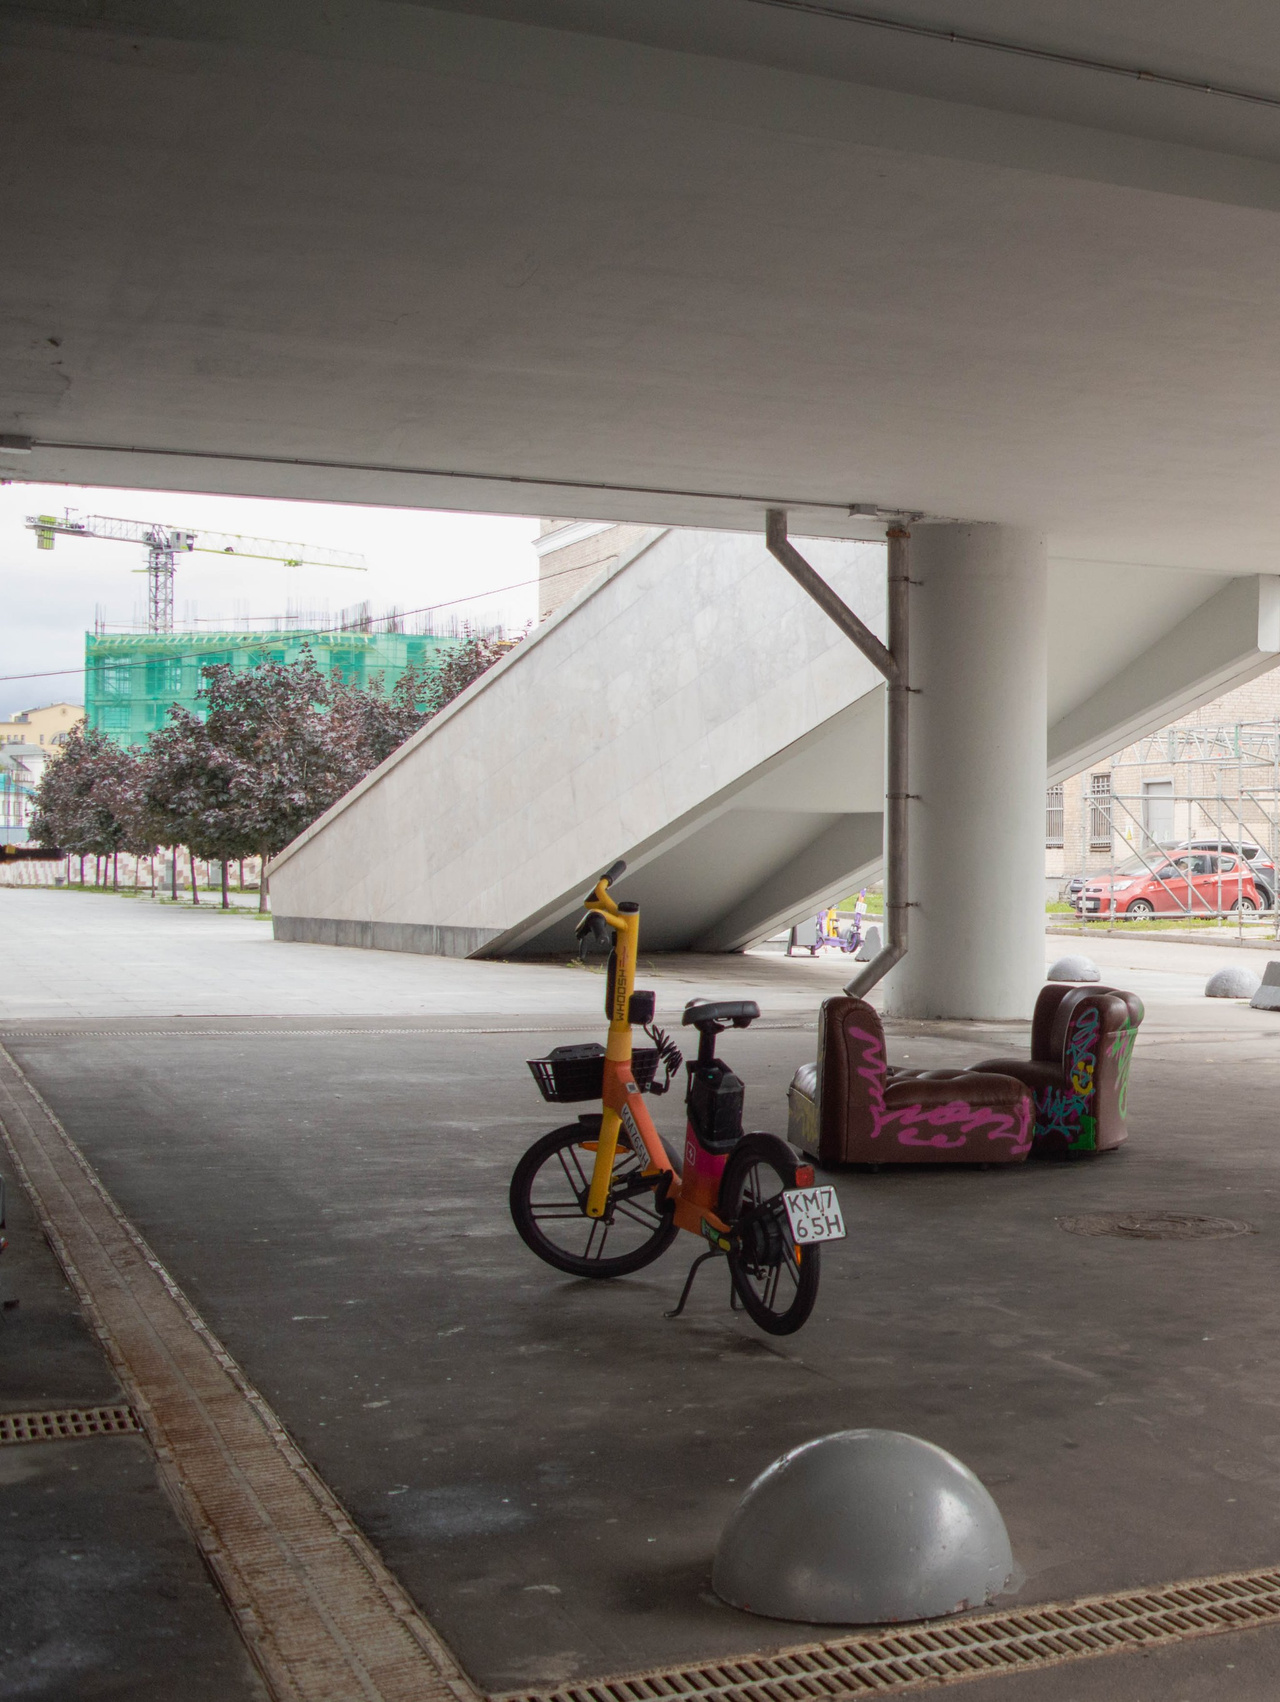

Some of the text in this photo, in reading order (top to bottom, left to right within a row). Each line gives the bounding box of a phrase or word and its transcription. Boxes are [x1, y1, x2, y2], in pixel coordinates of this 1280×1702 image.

[615, 969, 627, 1022] WHOOSH
[622, 1106, 649, 1167] KM765H
[787, 1190, 832, 1214] KM7
[796, 1214, 842, 1238] 65H
